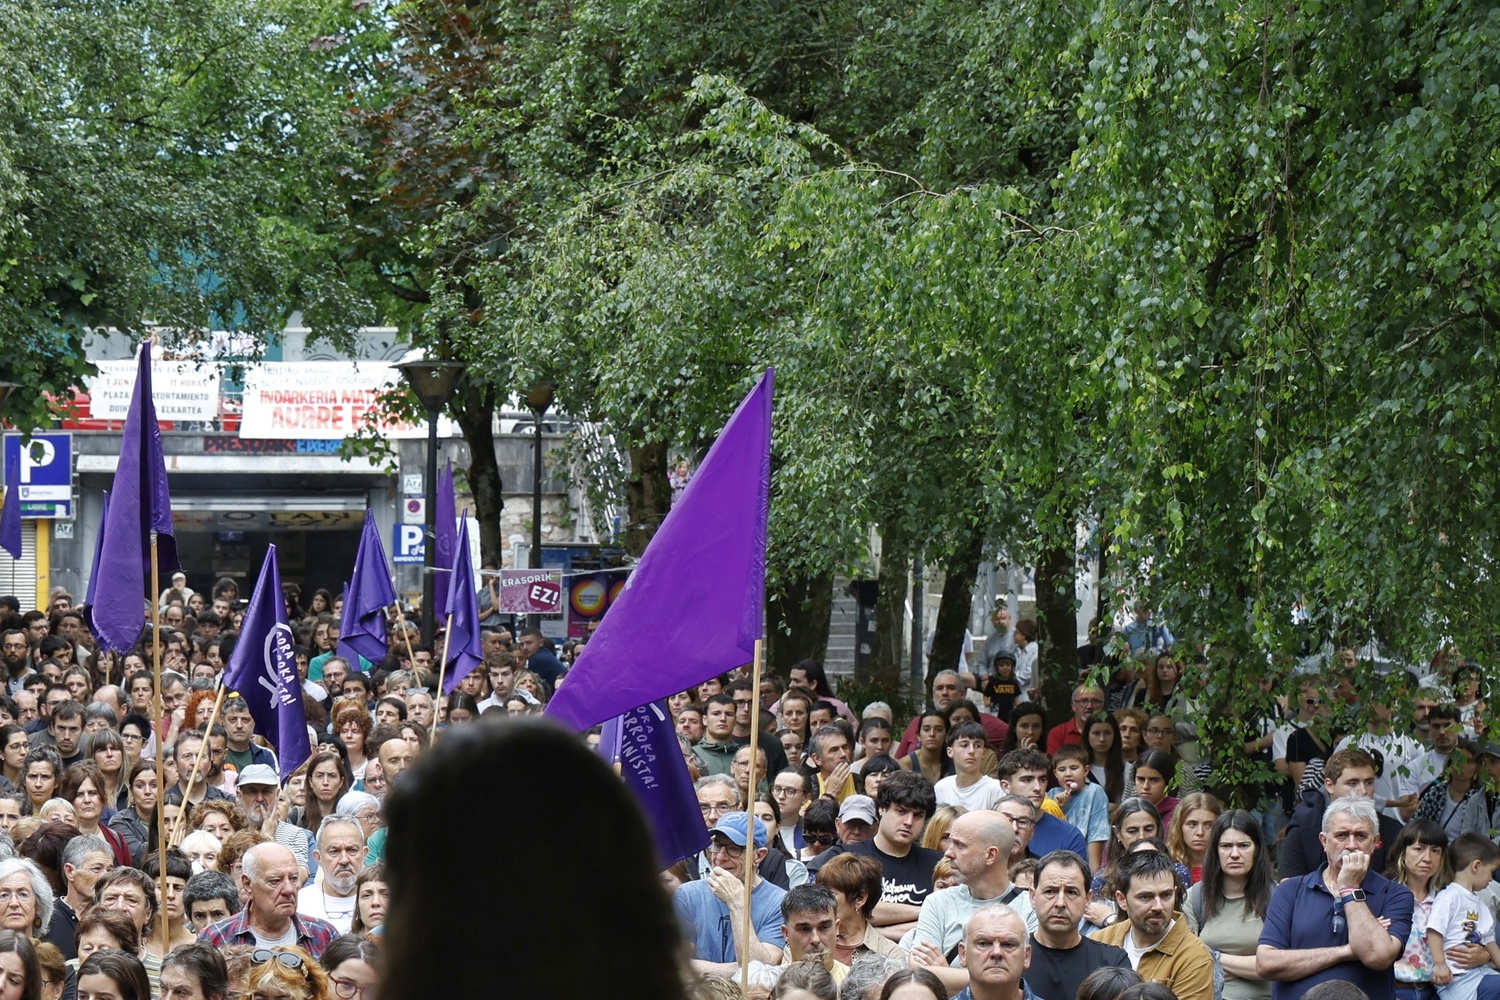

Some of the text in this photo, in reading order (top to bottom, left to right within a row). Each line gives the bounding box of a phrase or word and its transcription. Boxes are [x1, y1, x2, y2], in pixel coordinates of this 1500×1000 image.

[103, 391, 129, 399] PLAZA
[260, 389, 338, 405] INDARKERIA
[161, 406, 202, 414] ELKARTEA
[271, 405, 343, 430] AURRE
[20, 439, 55, 483] P
[401, 525, 424, 555] P
[502, 573, 553, 587] ERASORIK
[530, 585, 559, 605] EZ!
[993, 684, 1015, 694] VANS
[636, 706, 654, 734] ORA
